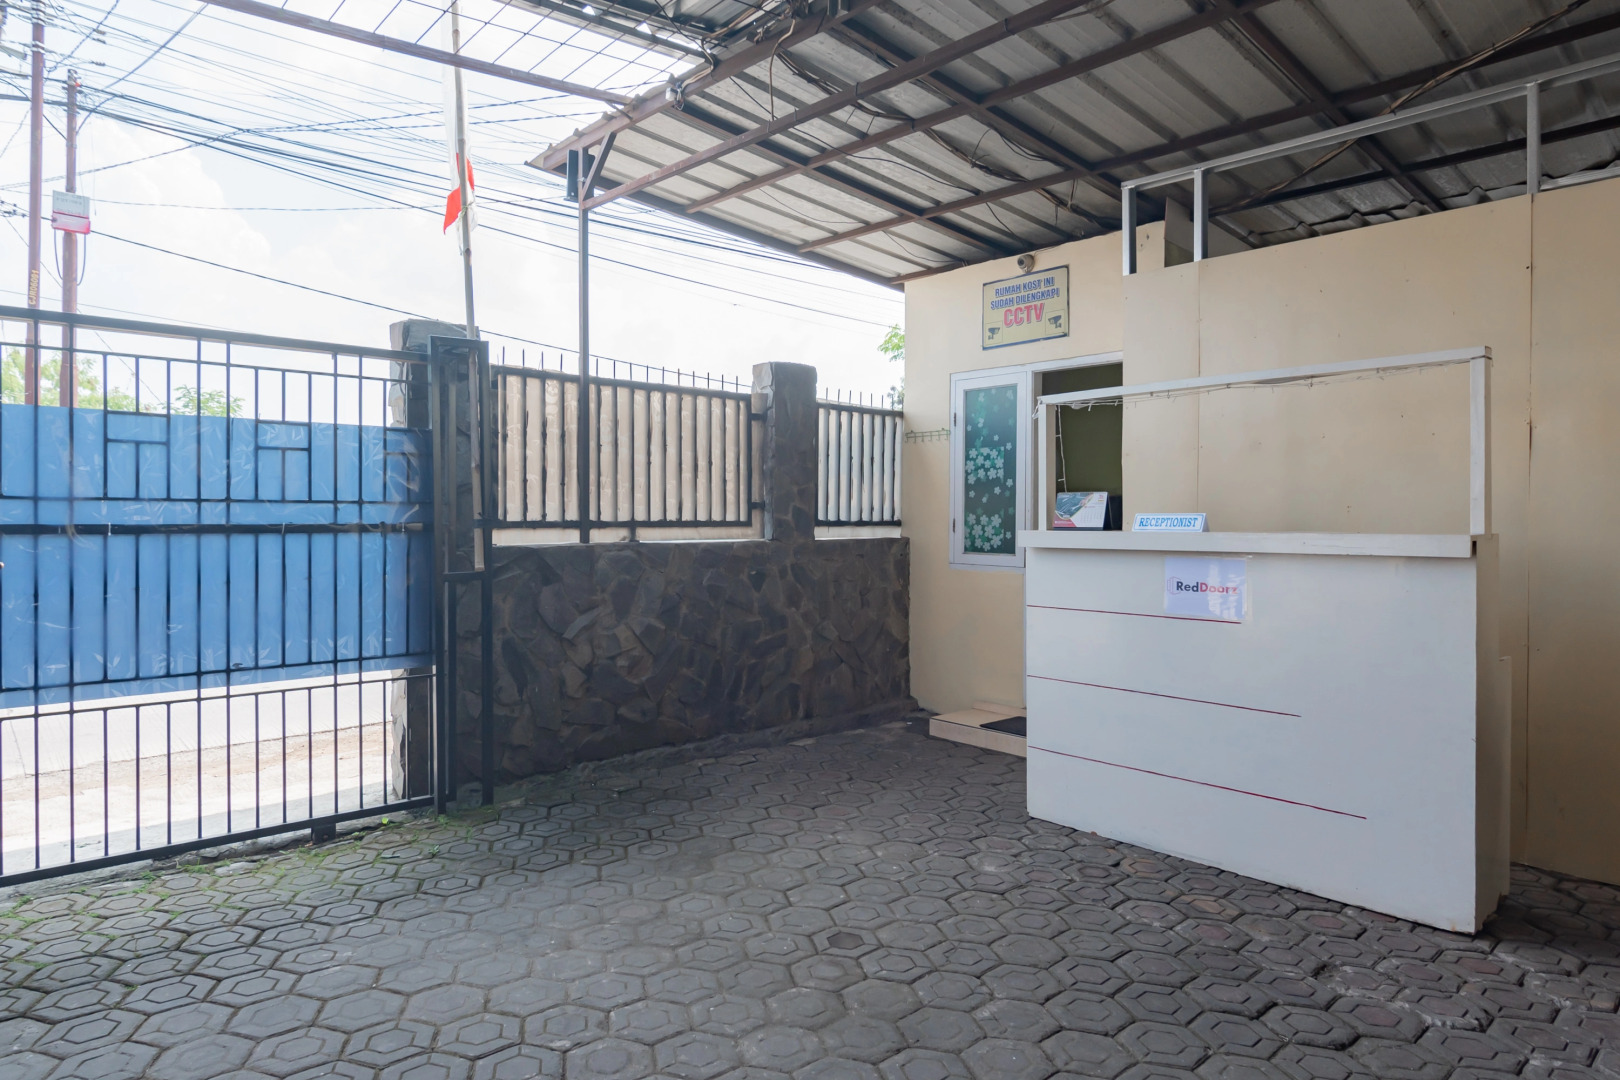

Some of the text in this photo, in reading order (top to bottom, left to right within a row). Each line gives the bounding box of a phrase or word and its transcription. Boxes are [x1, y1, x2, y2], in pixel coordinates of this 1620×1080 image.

[995, 276, 1055, 298] RUMAH KOST INI
[990, 287, 1060, 310] SUDAH DILENGKAPI
[1003, 303, 1045, 328] CCTV
[1138, 516, 1198, 528] RECEPTIONIST
[1176, 581, 1239, 594] RedDoorz
